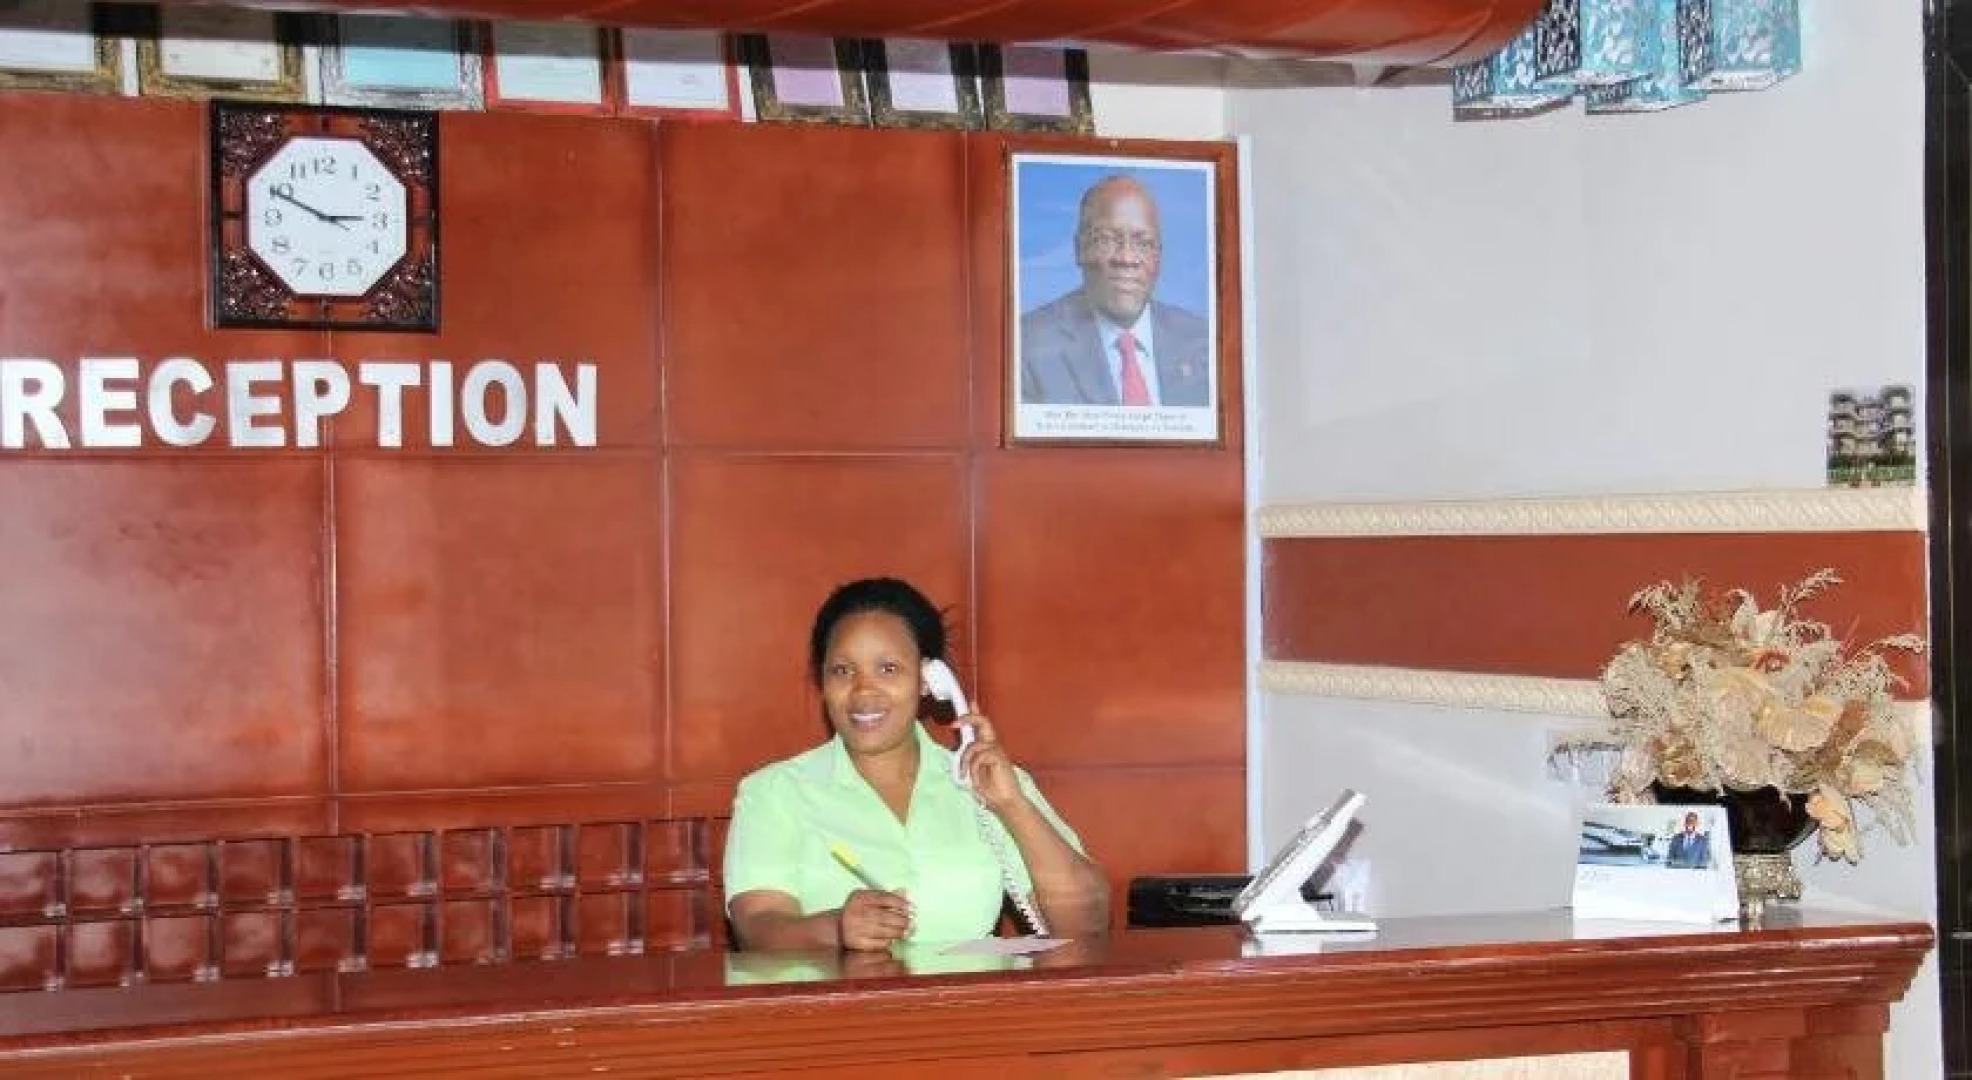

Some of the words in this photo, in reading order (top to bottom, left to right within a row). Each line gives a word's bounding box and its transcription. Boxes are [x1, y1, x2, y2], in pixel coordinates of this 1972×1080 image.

[313, 156, 337, 175] 12
[365, 183, 381, 201] 2
[264, 208, 282, 227] 9
[372, 212, 388, 229] 3
[271, 237, 291, 254] 8
[291, 257, 309, 276] 7
[318, 262, 334, 281] 6
[346, 258, 362, 275] 5
[0, 357, 598, 449] RECEPTION
